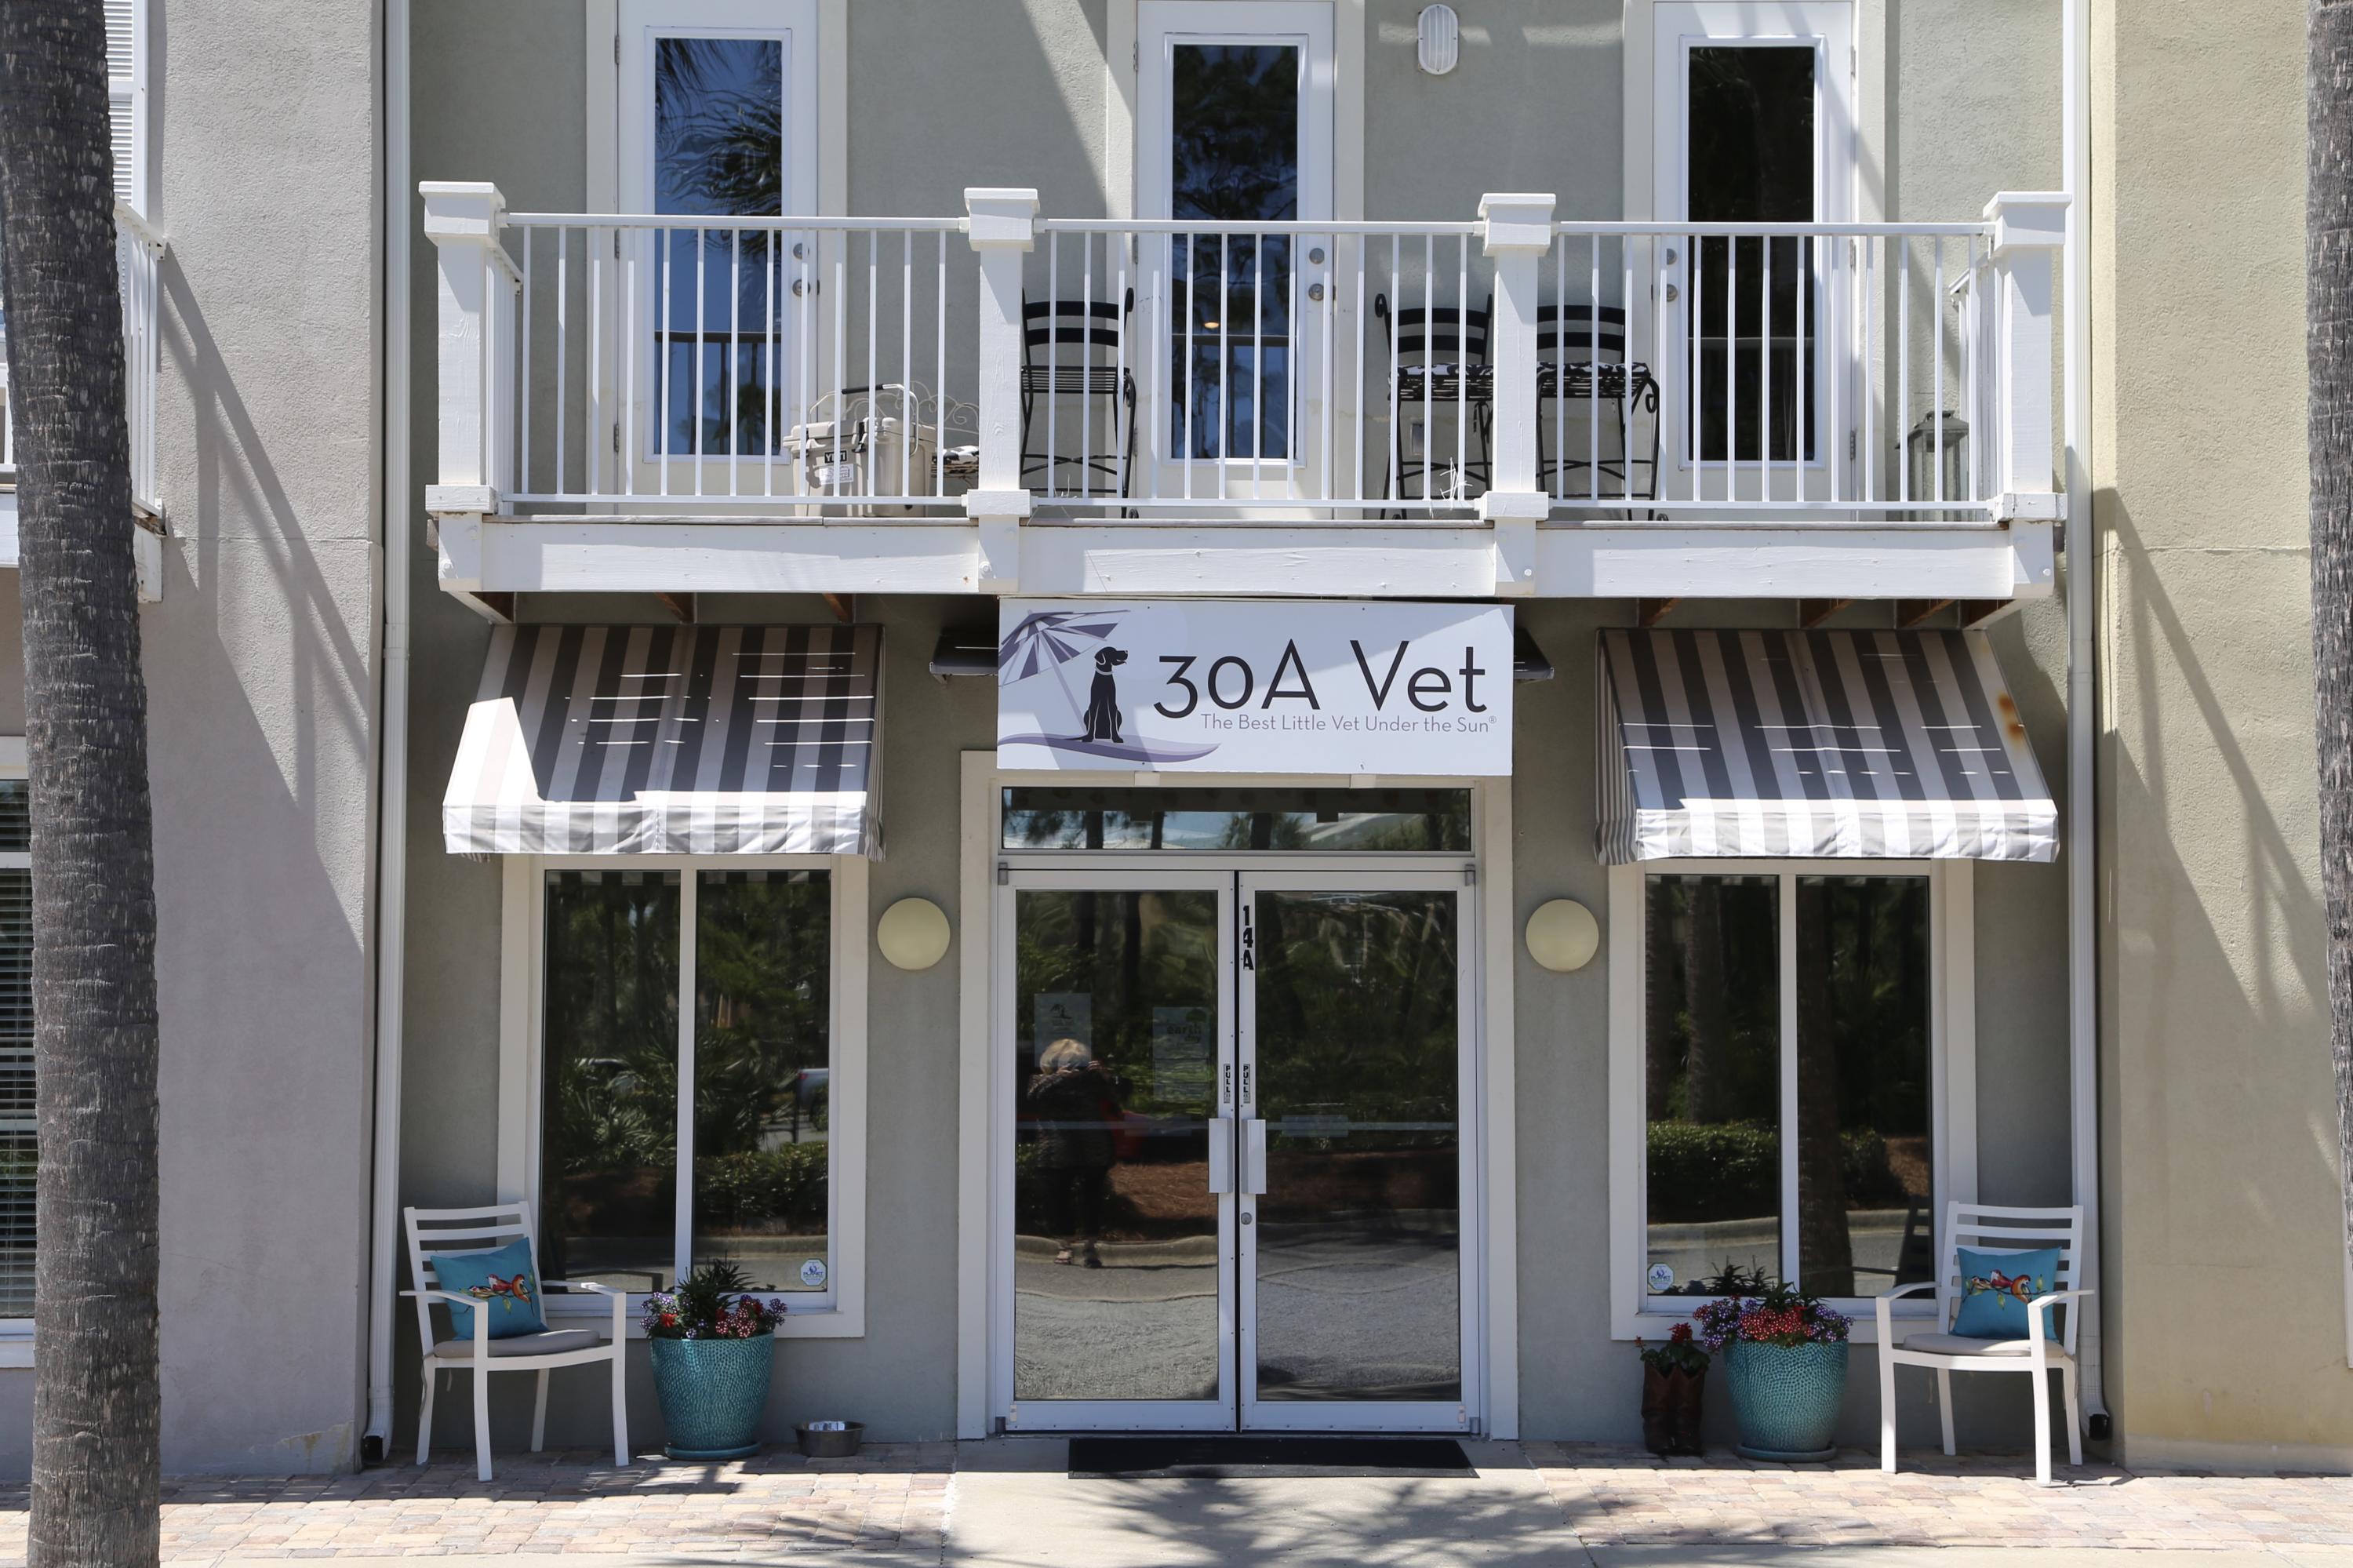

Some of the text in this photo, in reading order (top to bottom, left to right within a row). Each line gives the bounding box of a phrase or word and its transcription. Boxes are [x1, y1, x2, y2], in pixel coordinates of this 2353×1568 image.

[825, 452, 846, 462] YI
[1153, 638, 1487, 719] 30A Vet
[1201, 713, 1233, 729] The
[1238, 714, 1276, 730] Best
[1282, 714, 1326, 730] Little
[1331, 715, 1359, 731] Vet
[1366, 715, 1418, 732] Under
[1424, 715, 1451, 732] the
[1242, 905, 1254, 970] 14A
[1167, 1022, 1202, 1035] earth
